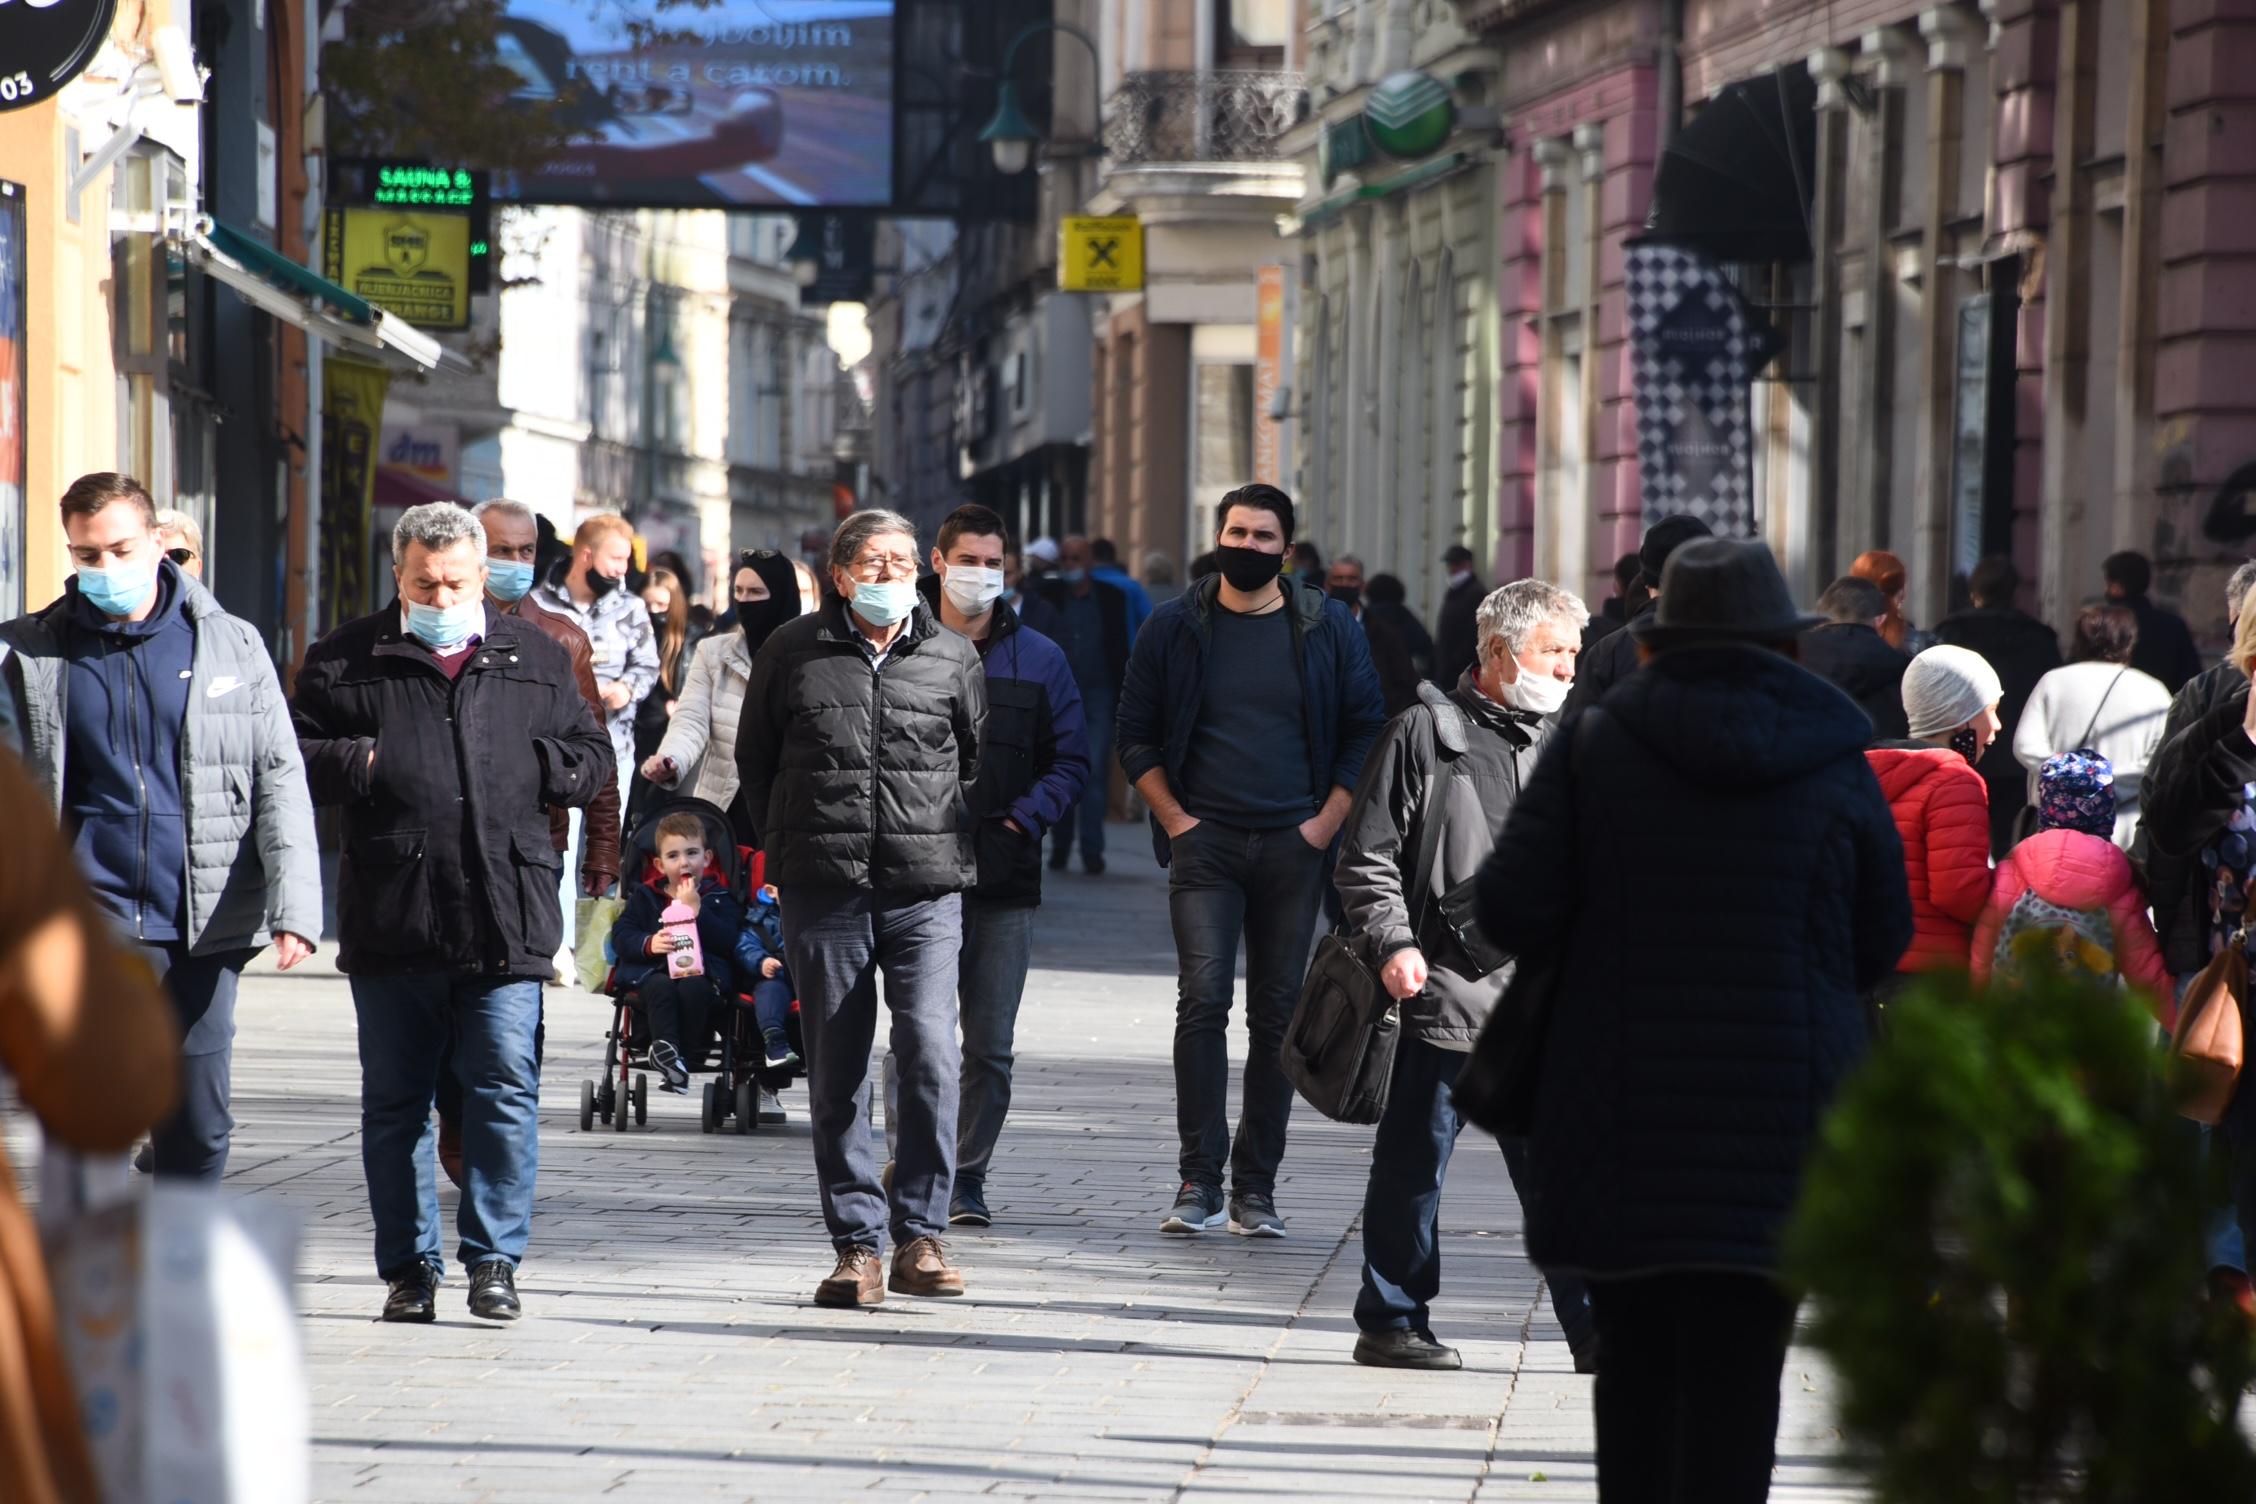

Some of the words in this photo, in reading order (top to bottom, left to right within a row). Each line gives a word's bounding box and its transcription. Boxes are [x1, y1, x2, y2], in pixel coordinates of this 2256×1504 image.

[565, 59, 651, 80] rent
[668, 63, 690, 82] a
[379, 166, 450, 188] SAUNA
[1257, 359, 1274, 482] ANKOMAT
[390, 430, 441, 463] dm
